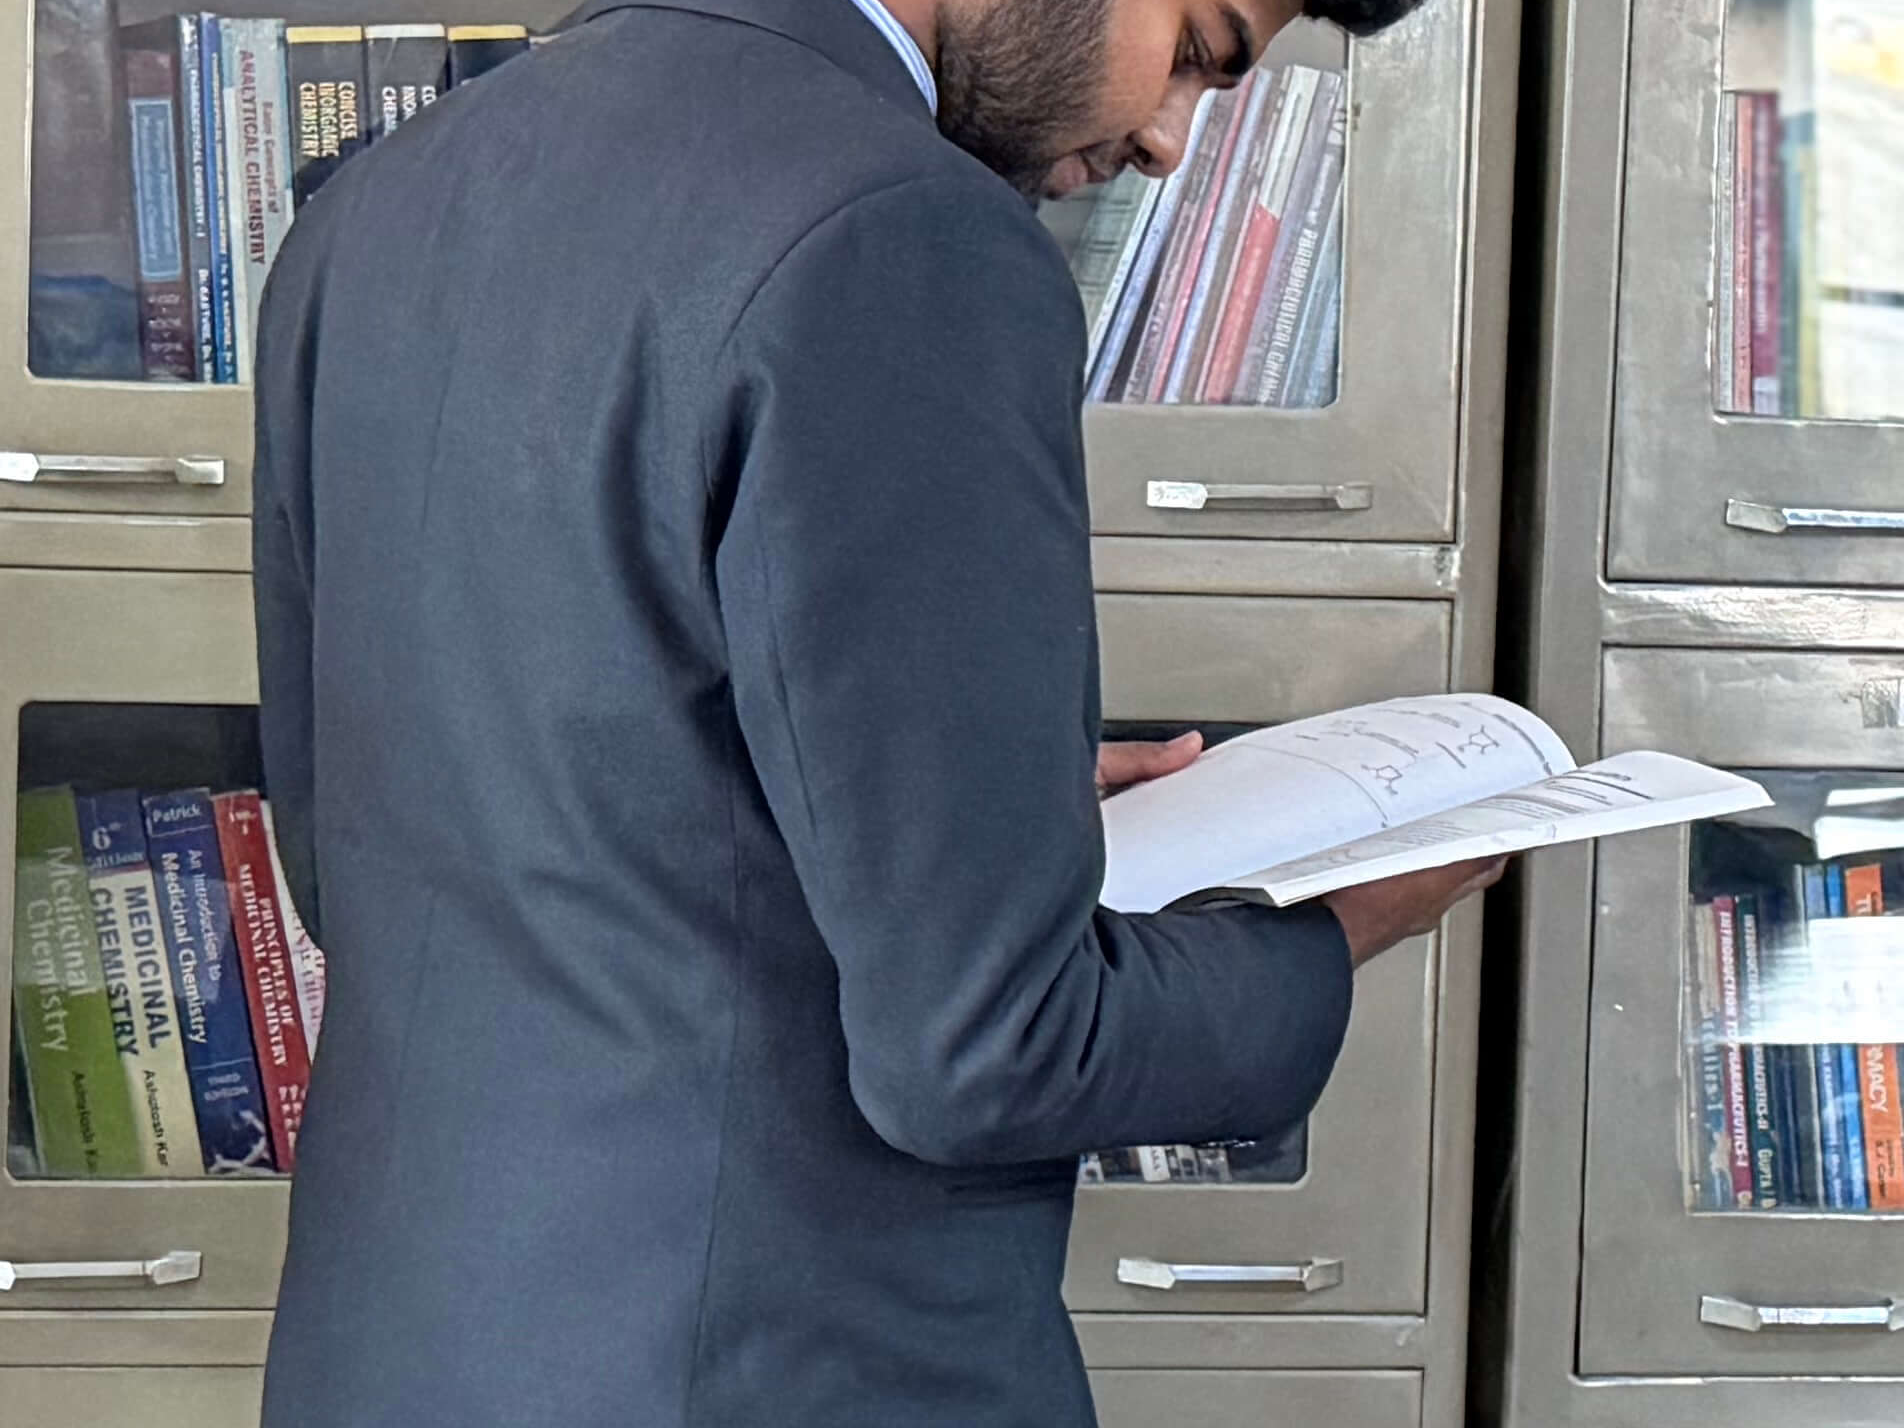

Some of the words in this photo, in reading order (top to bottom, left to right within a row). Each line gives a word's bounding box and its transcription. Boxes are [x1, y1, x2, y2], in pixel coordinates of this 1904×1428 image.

[238, 49, 260, 157] ANALYTICAL
[299, 82, 318, 157] CHEMISTRY
[338, 81, 357, 139] CONCISE
[245, 161, 266, 266] CHEMISTRY
[152, 803, 201, 823] Patrick
[27, 898, 69, 1052] Chemistry
[46, 846, 91, 997] Medicinal
[89, 888, 140, 1056] CHEMISTRY
[124, 885, 172, 1050] MEDICINAL
[161, 852, 194, 943] Medicinal
[178, 949, 208, 1044] Chemistry
[1720, 910, 1738, 1017] INTRODUCTION
